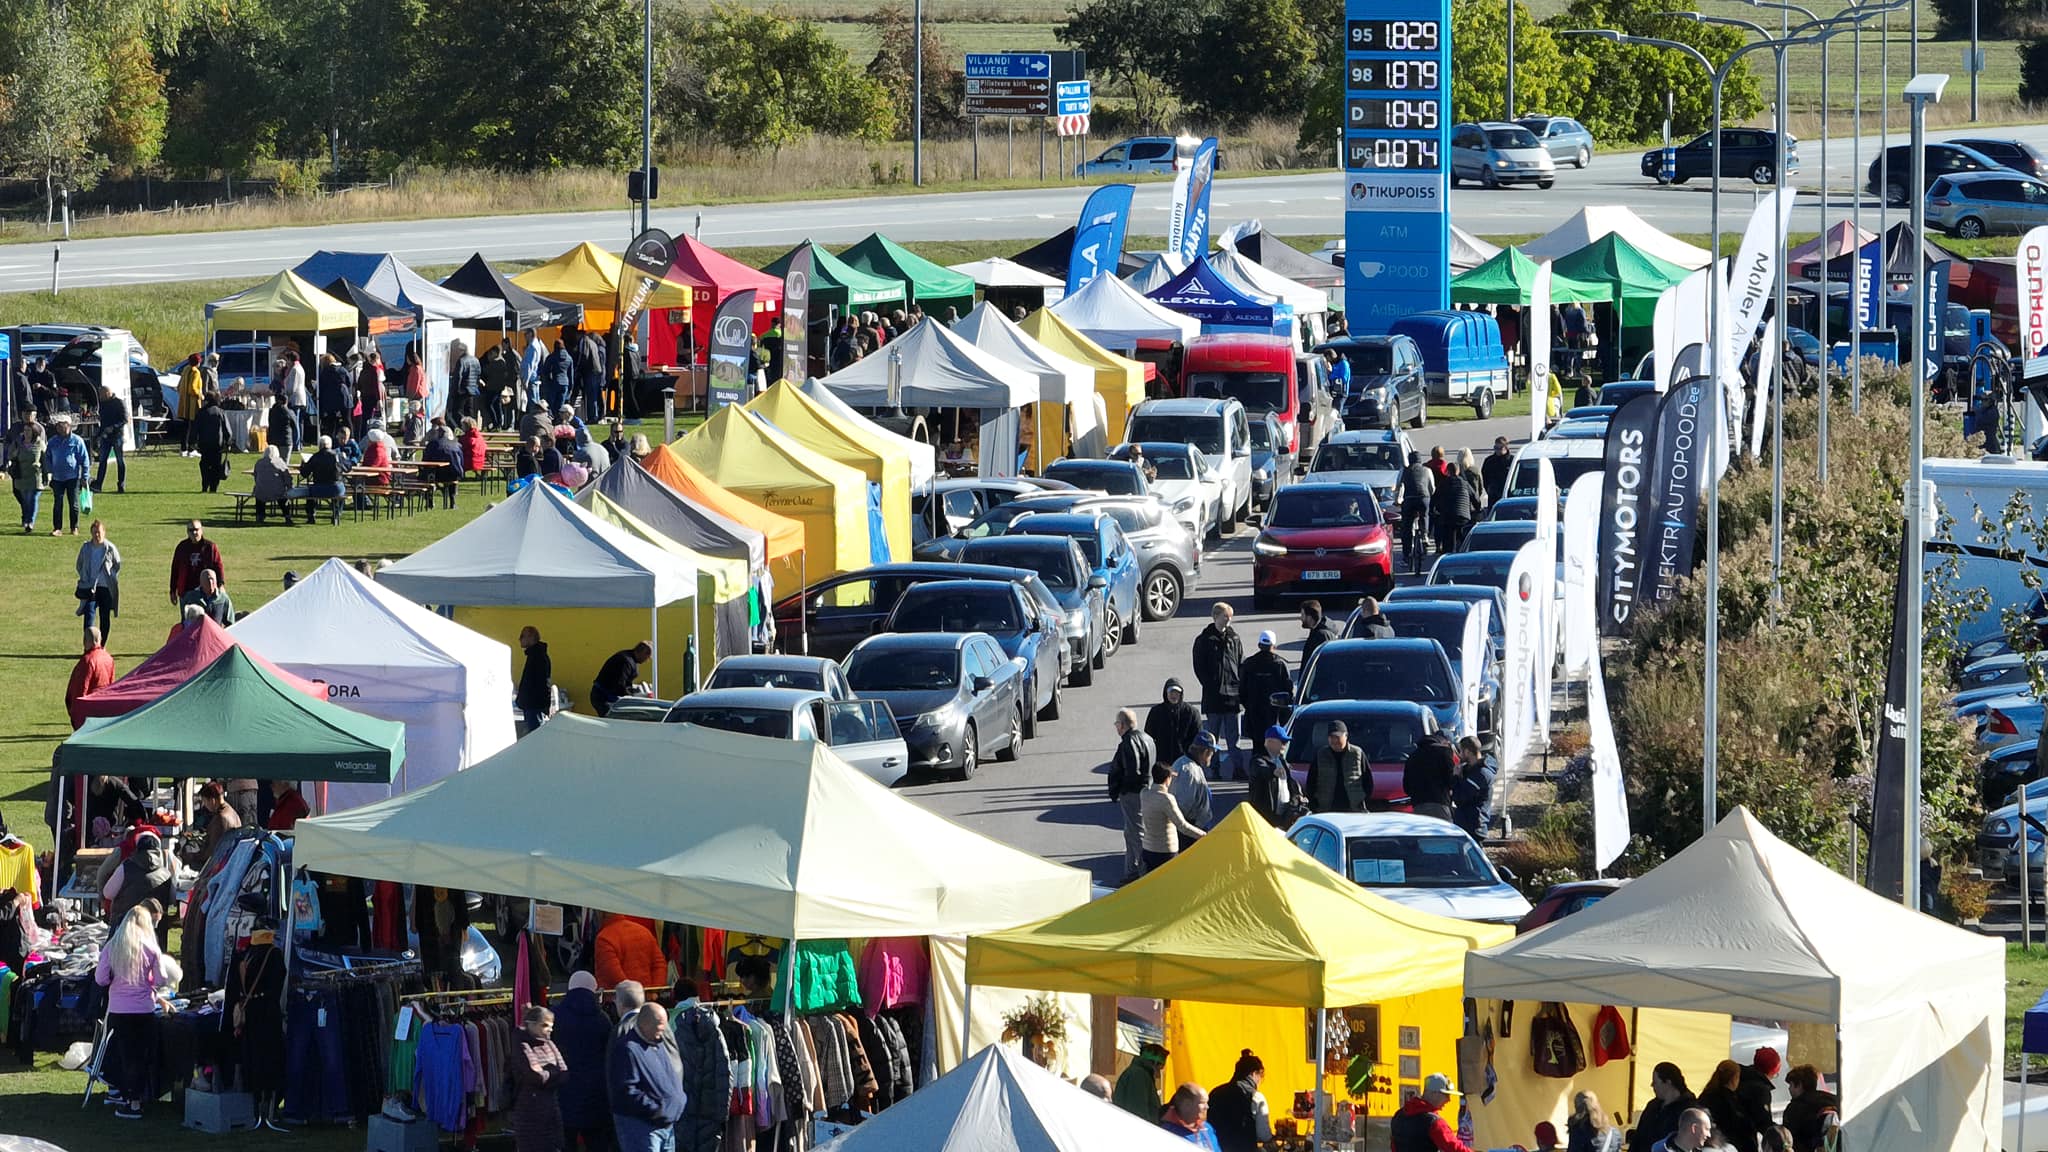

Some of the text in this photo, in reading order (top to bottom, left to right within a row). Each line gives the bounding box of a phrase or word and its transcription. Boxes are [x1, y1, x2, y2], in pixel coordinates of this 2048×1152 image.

[1352, 21, 1437, 50] 95 1.829
[968, 56, 1010, 65] VILJANDI
[968, 66, 1009, 75] IMAVERE
[1352, 61, 1437, 89] 98 1.879
[1352, 100, 1437, 128] D 1.849
[1352, 139, 1438, 167] LPG 0.874
[1367, 186, 1435, 199] TIKUPOISS
[1380, 225, 1408, 239] ATM
[1388, 265, 1429, 279] POOD
[1150, 297, 1238, 306] ALEXELA
[1235, 313, 1270, 322] ALEXELA
[1929, 270, 1938, 351] CUPRA
[1613, 427, 1644, 625] CITYMOTORS
